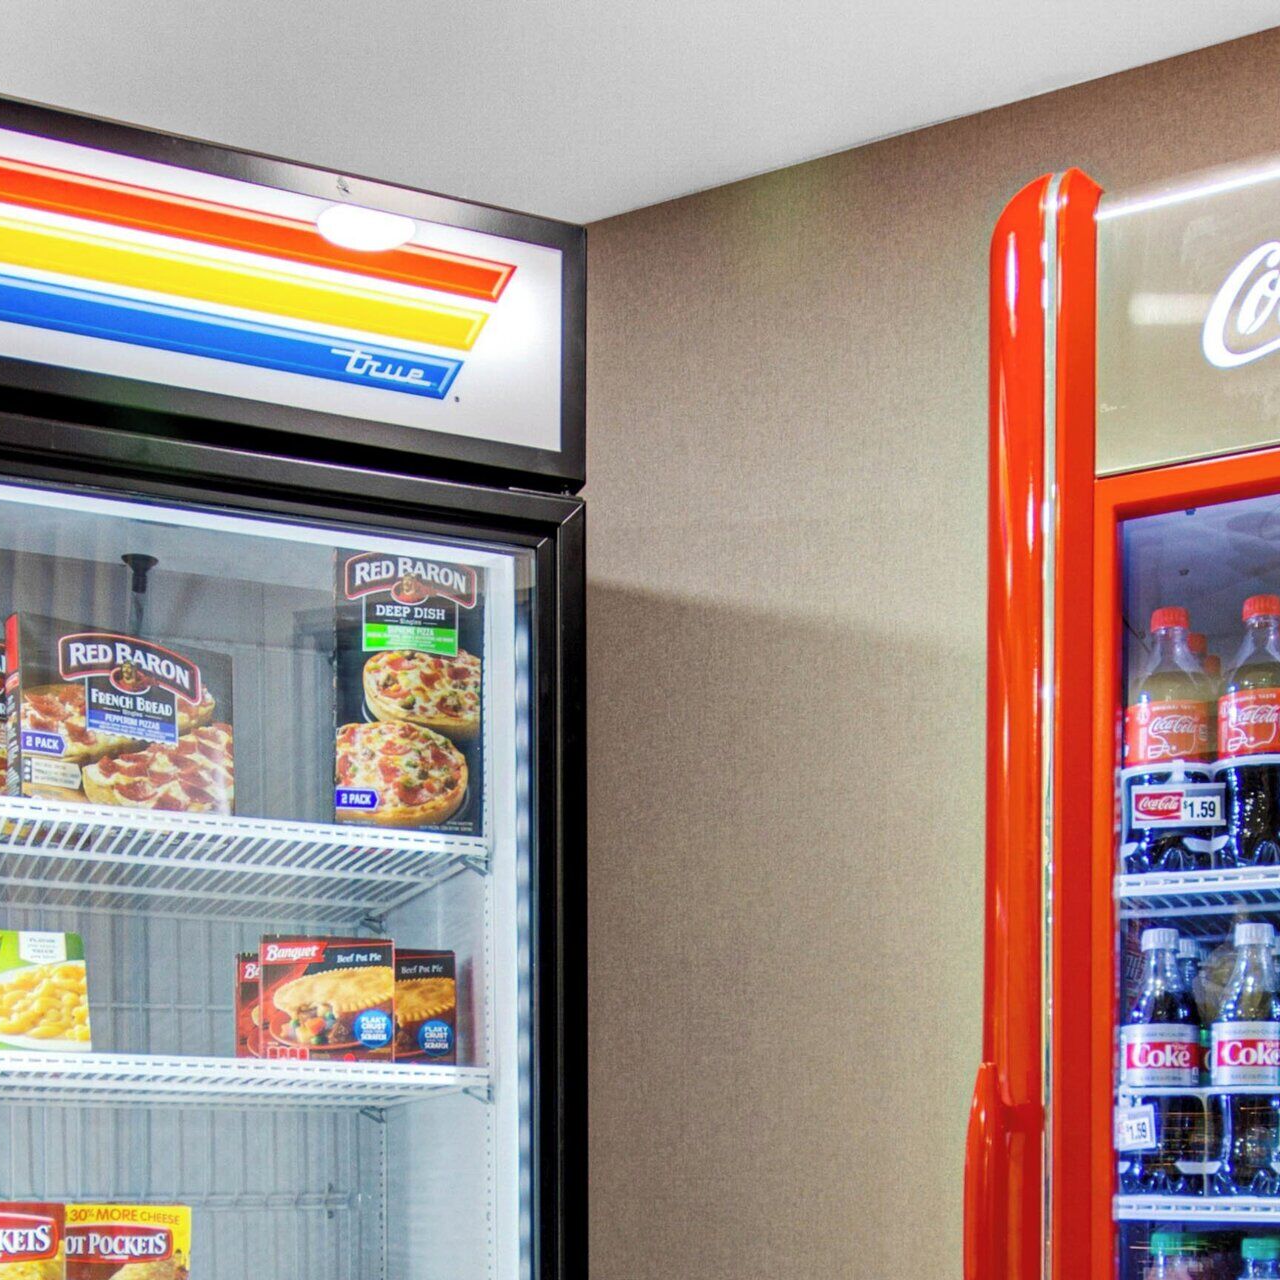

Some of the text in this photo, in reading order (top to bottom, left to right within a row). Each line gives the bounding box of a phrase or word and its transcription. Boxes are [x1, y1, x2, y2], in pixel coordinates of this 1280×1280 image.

[330, 350, 432, 387] true
[355, 556, 467, 594] RED BARON
[376, 604, 446, 621] DEEP DISH
[69, 641, 192, 689] RED BARON
[91, 688, 173, 717] FRENCH BREAD
[26, 735, 59, 751] 2 PACK
[341, 792, 372, 805] 2 PACK
[1183, 800, 1216, 818] $1.59
[265, 943, 320, 962] Banquet
[336, 952, 382, 963] Beef Pot Pie
[401, 964, 443, 974] Beef Pot Pie
[424, 1026, 448, 1034] FLAKY
[424, 1032, 448, 1040] CRUST
[1132, 1044, 1191, 1068] Coke
[70, 1208, 181, 1225] 30% MORE CHEESE
[88, 1232, 168, 1256] POCKETS
